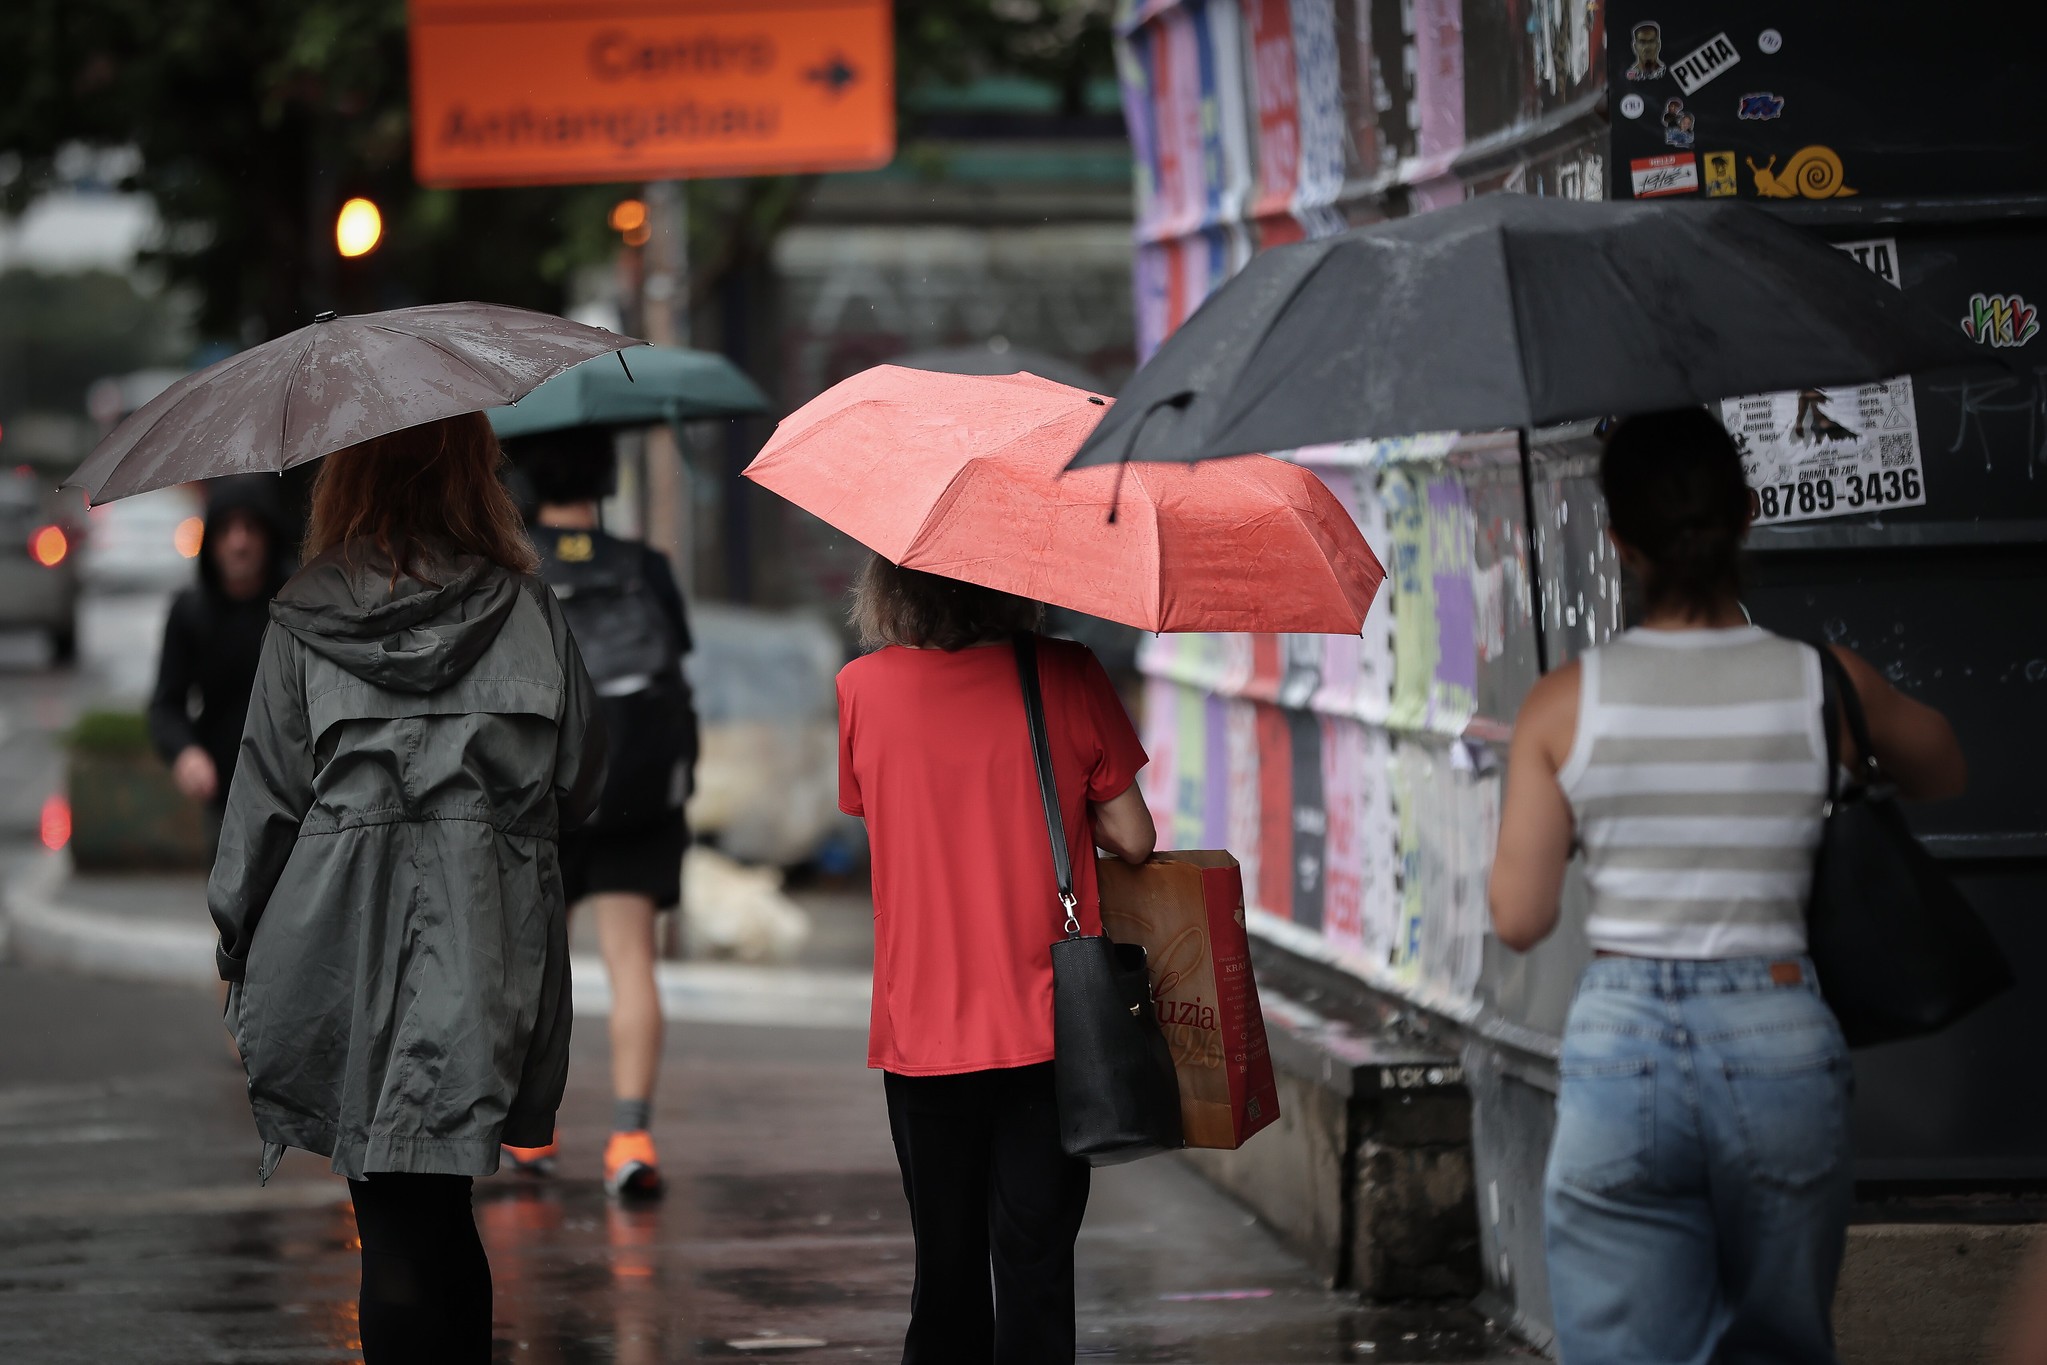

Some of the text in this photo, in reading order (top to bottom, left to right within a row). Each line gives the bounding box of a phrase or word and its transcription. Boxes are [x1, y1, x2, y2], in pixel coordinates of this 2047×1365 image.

[589, 29, 778, 81] Centro
[1674, 38, 1734, 88] PILHA
[1649, 155, 1676, 166] HELLO
[1850, 245, 1893, 280] TA
[1798, 467, 1825, 481] CHAMA
[1828, 465, 1840, 477] NO
